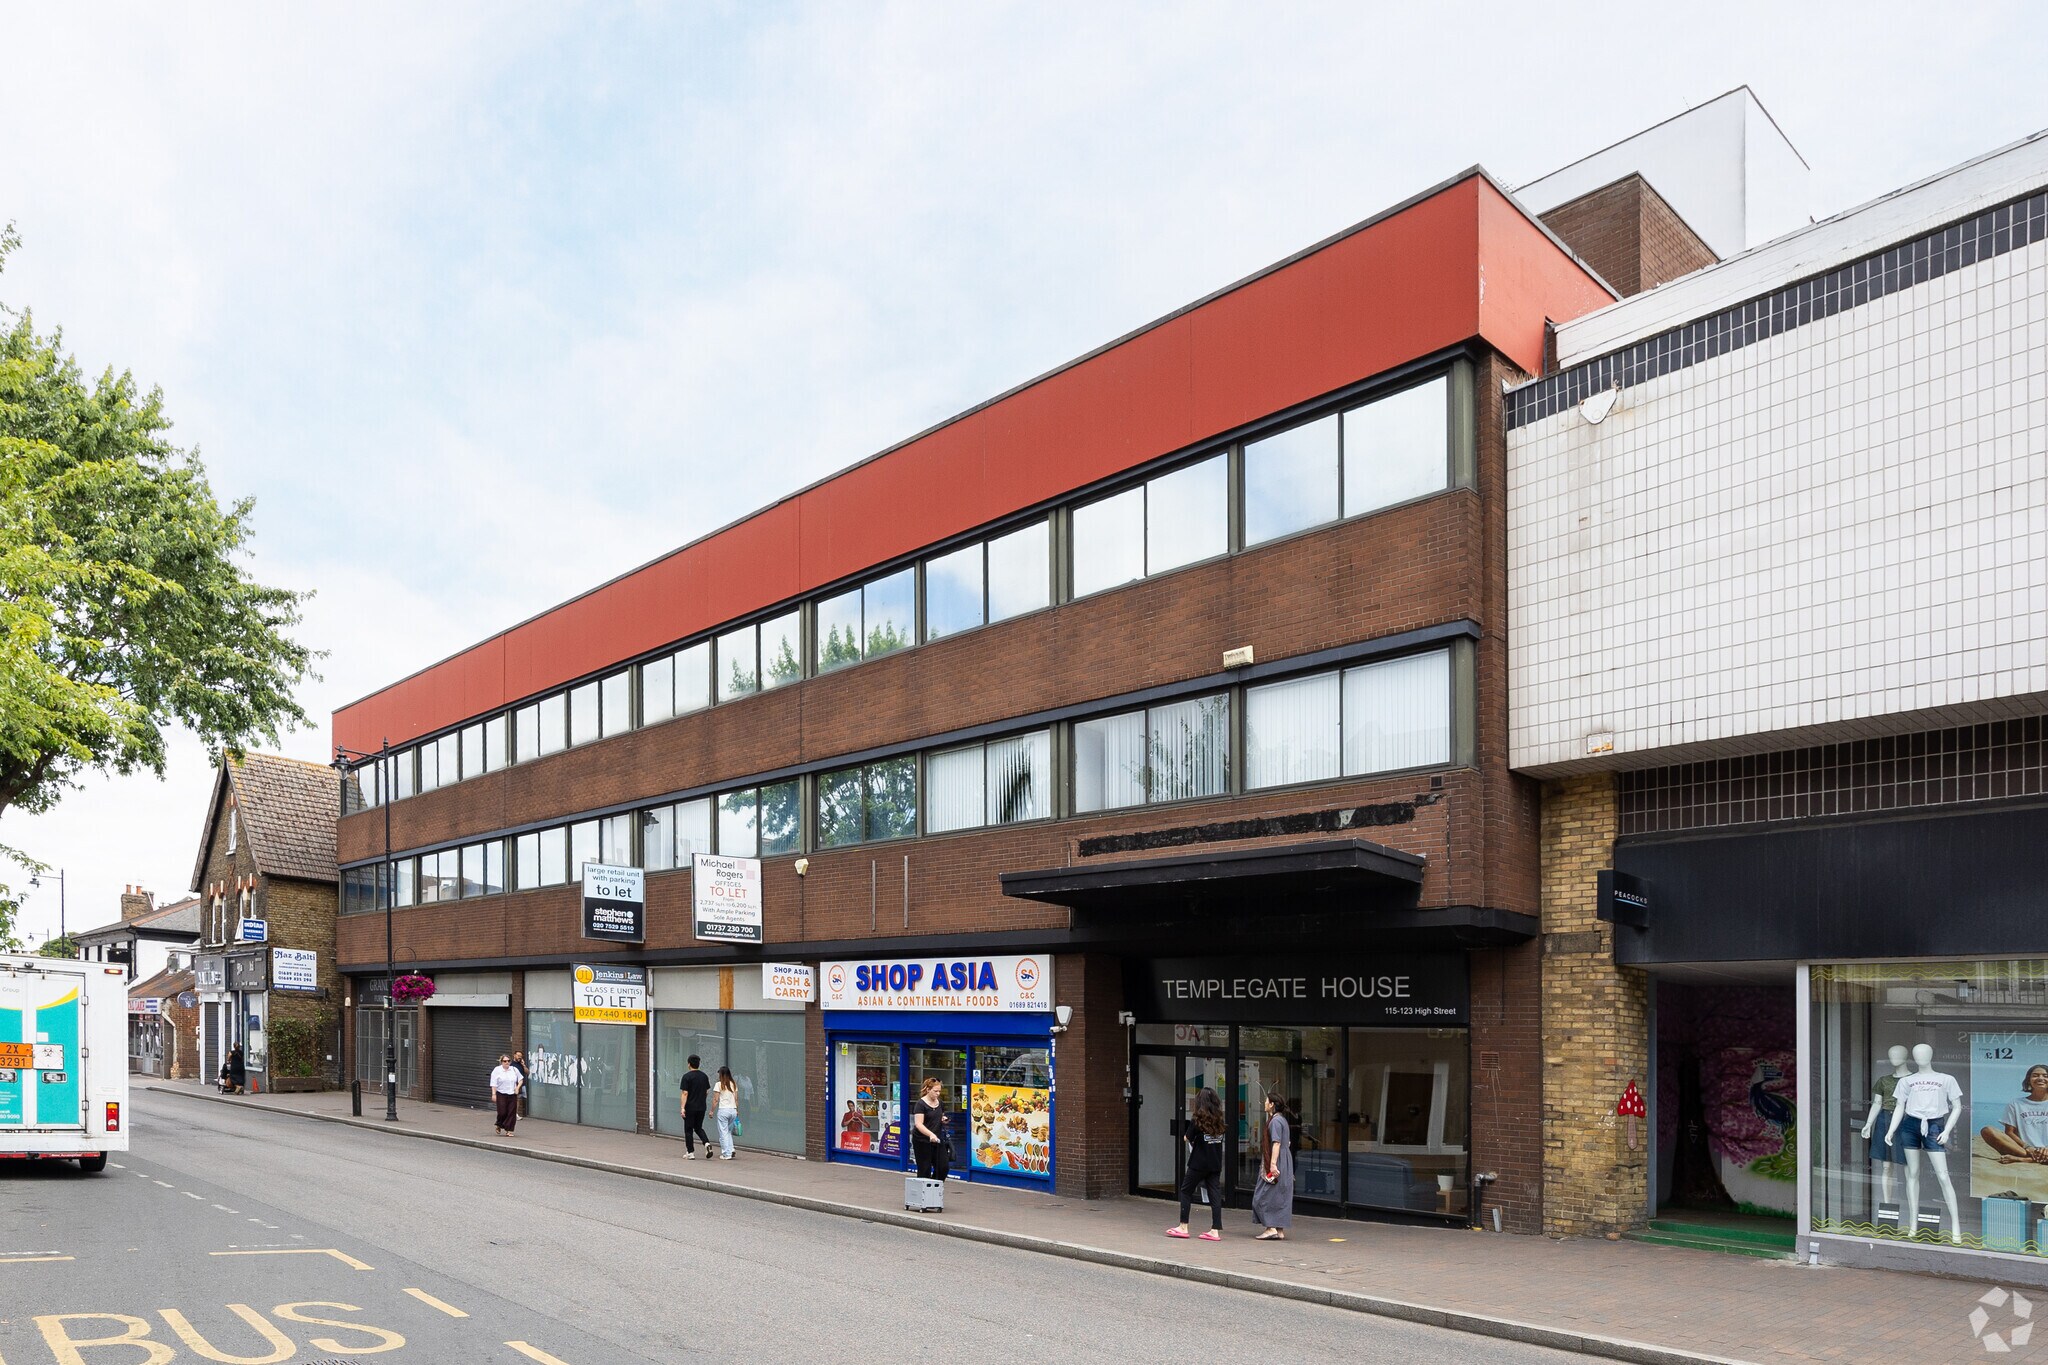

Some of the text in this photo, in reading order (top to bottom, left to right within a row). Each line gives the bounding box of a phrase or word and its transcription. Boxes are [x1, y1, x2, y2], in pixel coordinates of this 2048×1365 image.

[701, 859, 735, 869] Michael
[716, 869, 744, 880] Rogers
[610, 877, 636, 886] parking
[596, 885, 632, 898] to let
[710, 886, 748, 898] TO LET
[1614, 890, 1648, 904] PEACOCKS
[594, 908, 626, 918] stephen
[594, 914, 634, 924] matthews
[275, 950, 316, 961] Naz Balti
[596, 970, 624, 980] Jenkins
[856, 962, 999, 992] SHOP ASIA
[772, 976, 811, 987] CASH &
[1162, 976, 1410, 998] TEMPLEGATE HOUSE
[775, 988, 810, 998] CARRY
[584, 994, 636, 1008] TO LET
[858, 996, 998, 1006] ASIAN & CONTINENTAL FOODS
[579, 1008, 642, 1019] 020 7440 1840
[1414, 1007, 1432, 1016] High
[1434, 1007, 1456, 1015] Street
[6, 1044, 18, 1054] 2X
[1984, 1048, 2013, 1060] £12
[0, 1057, 26, 1067] 3291
[32, 1301, 406, 1365] BUS
